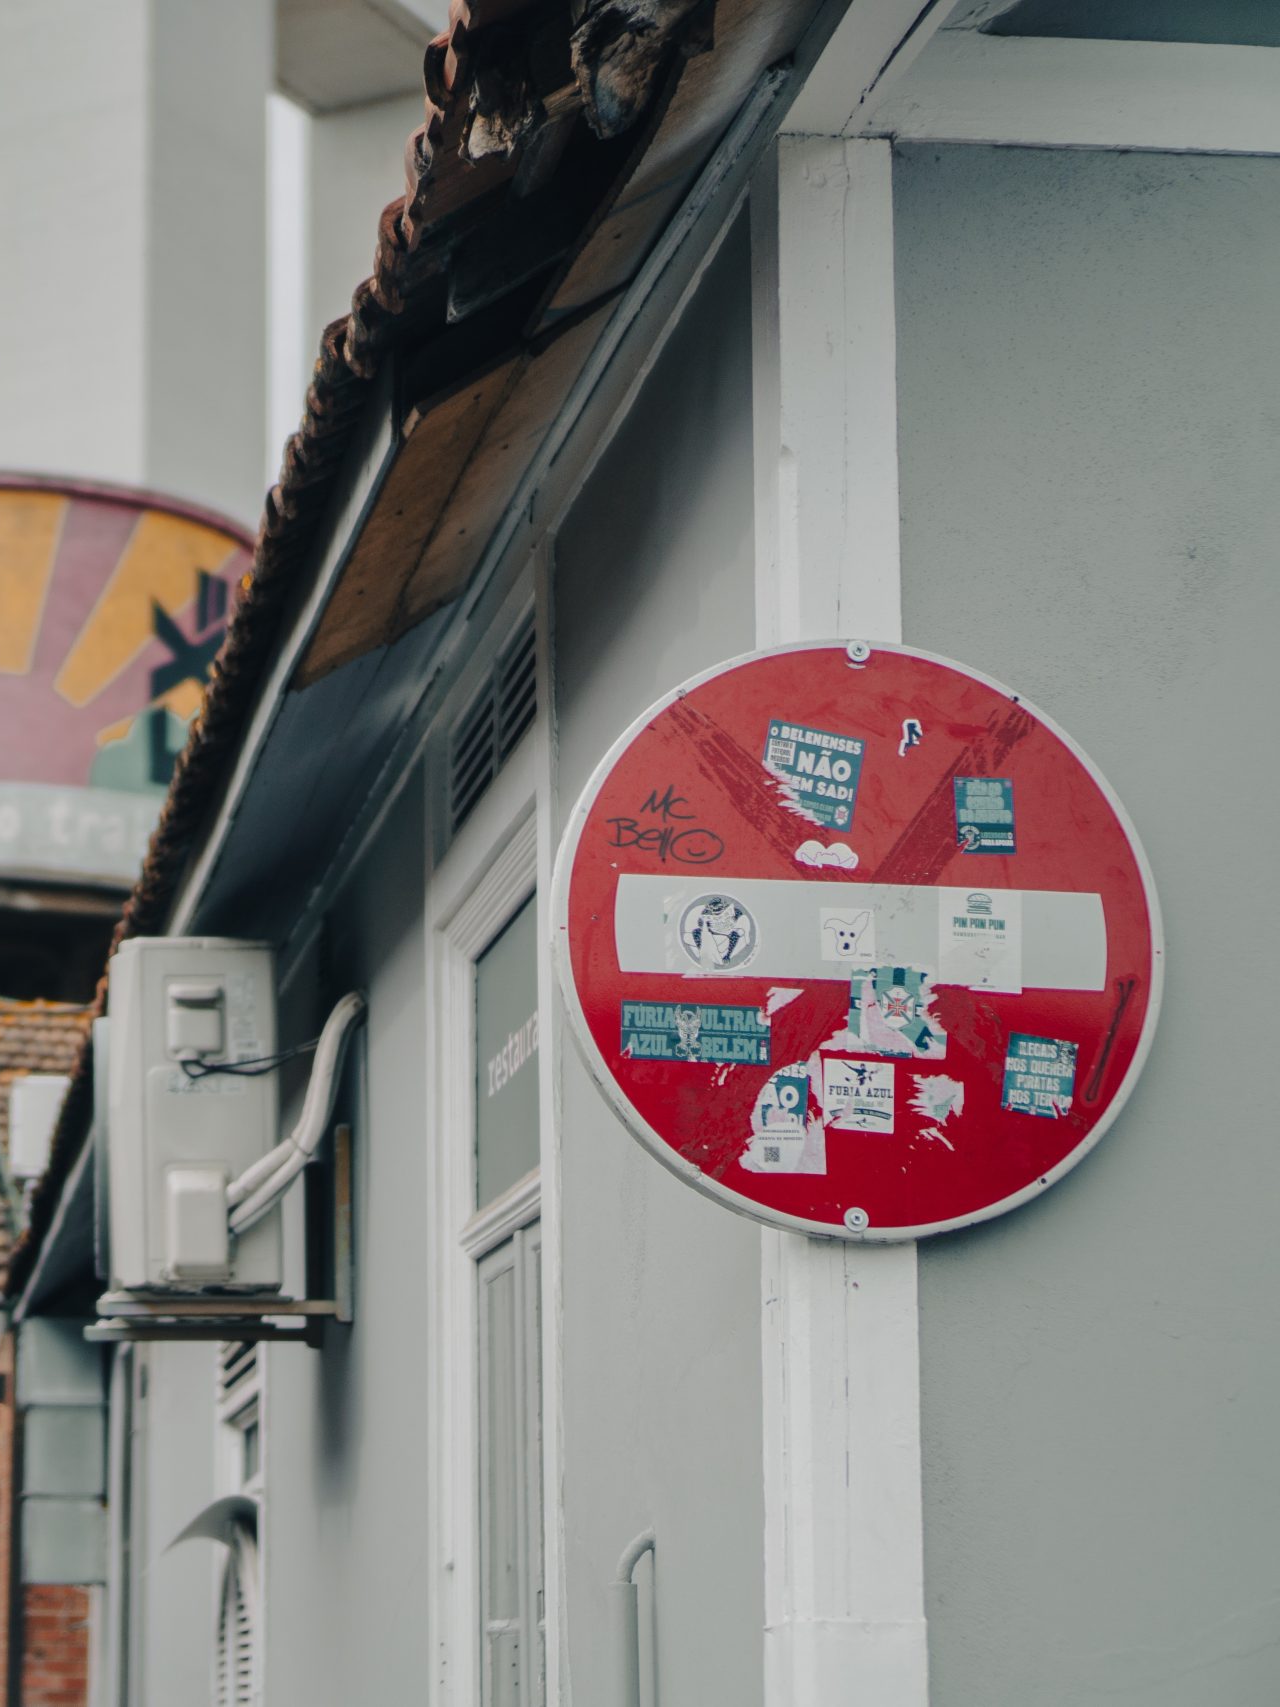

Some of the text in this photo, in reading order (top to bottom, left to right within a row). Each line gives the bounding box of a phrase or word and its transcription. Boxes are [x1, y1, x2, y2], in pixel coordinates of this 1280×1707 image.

[770, 726, 862, 756] O BELENENSES
[796, 749, 852, 783] NÃO
[816, 781, 854, 802] SAD!
[628, 1033, 758, 1060] AZUL BELÉM
[1005, 1057, 1027, 1072] NOS
[866, 1086, 894, 1099] AZUL
[1016, 1074, 1060, 1091] PIRATAS
